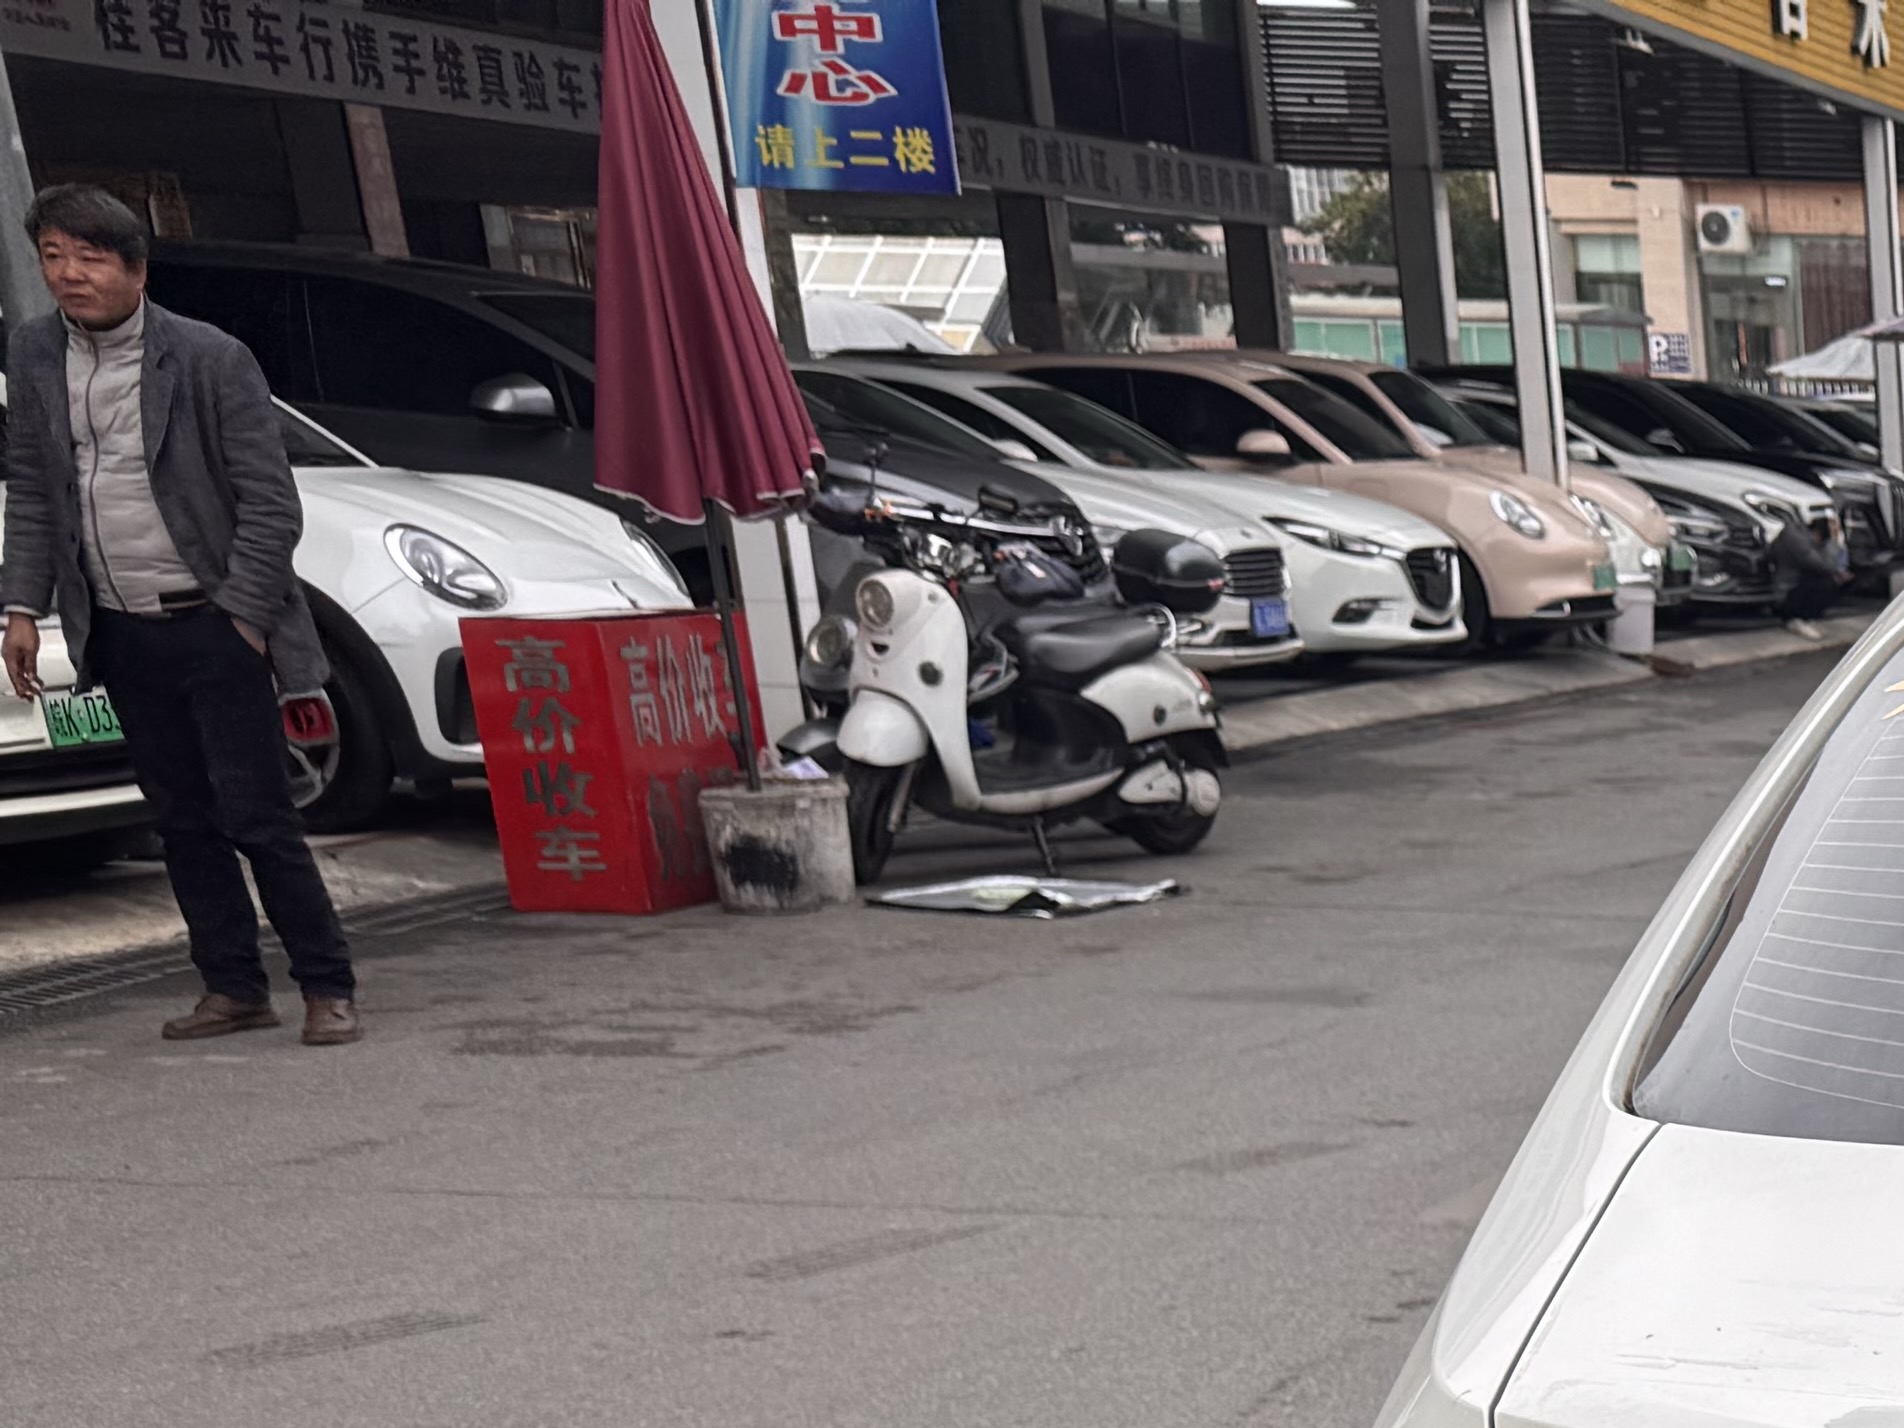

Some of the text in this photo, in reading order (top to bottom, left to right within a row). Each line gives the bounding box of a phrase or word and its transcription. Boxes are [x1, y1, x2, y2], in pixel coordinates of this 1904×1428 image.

[772, 1, 899, 107] 中心
[755, 123, 936, 175] 请上二楼
[495, 635, 607, 881] 高价收车
